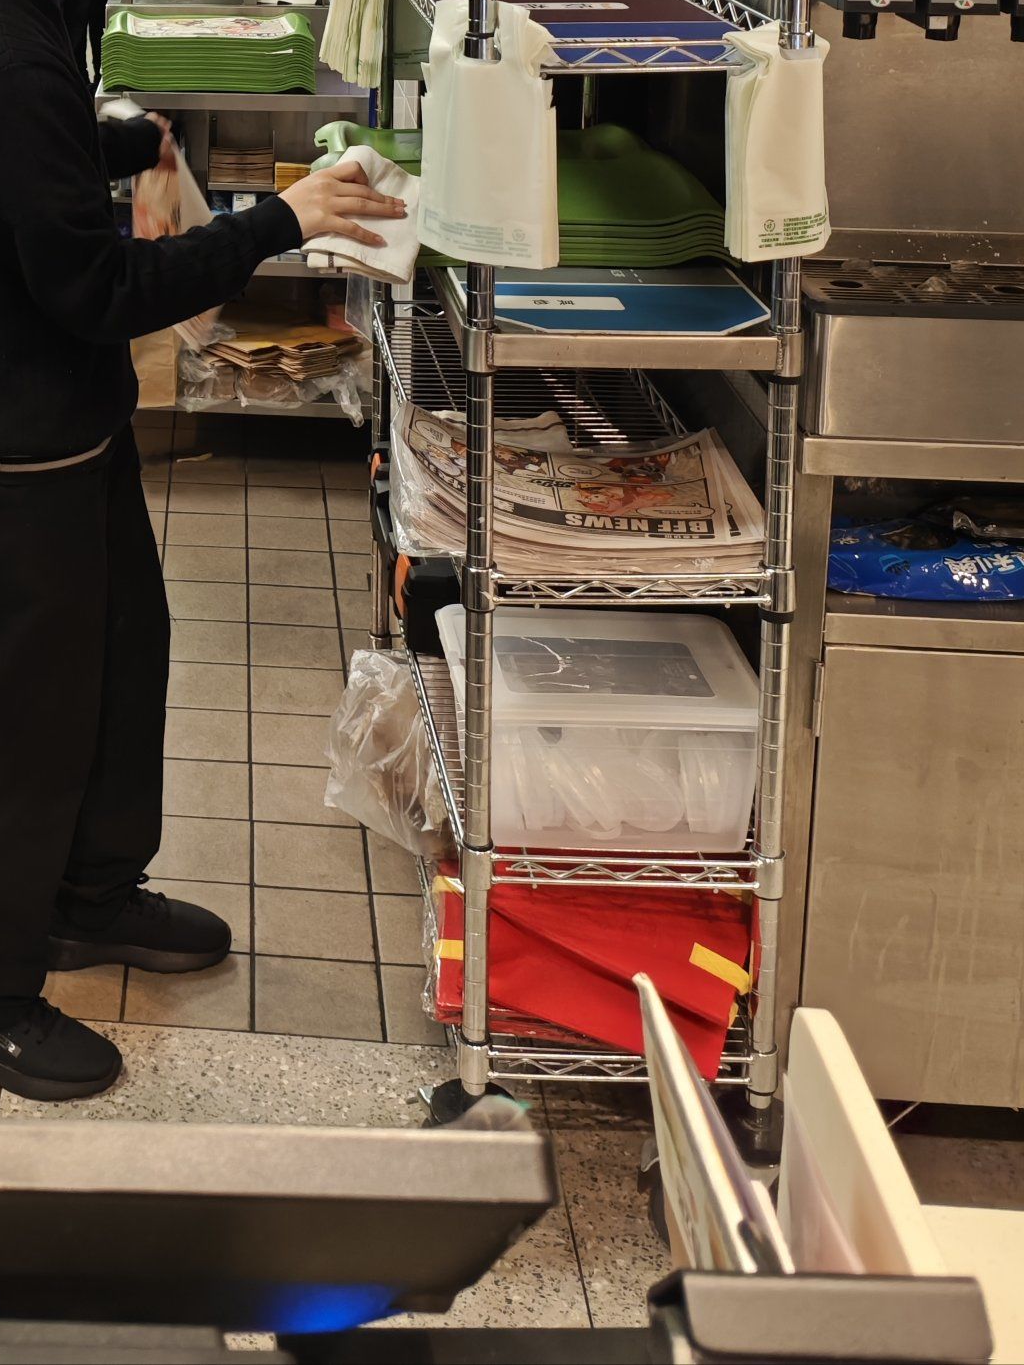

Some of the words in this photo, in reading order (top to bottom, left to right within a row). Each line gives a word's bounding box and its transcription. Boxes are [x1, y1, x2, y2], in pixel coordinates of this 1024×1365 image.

[564, 512, 650, 532] NEWS
[657, 519, 709, 534] BFF
[943, 551, 1024, 577] 利奥
